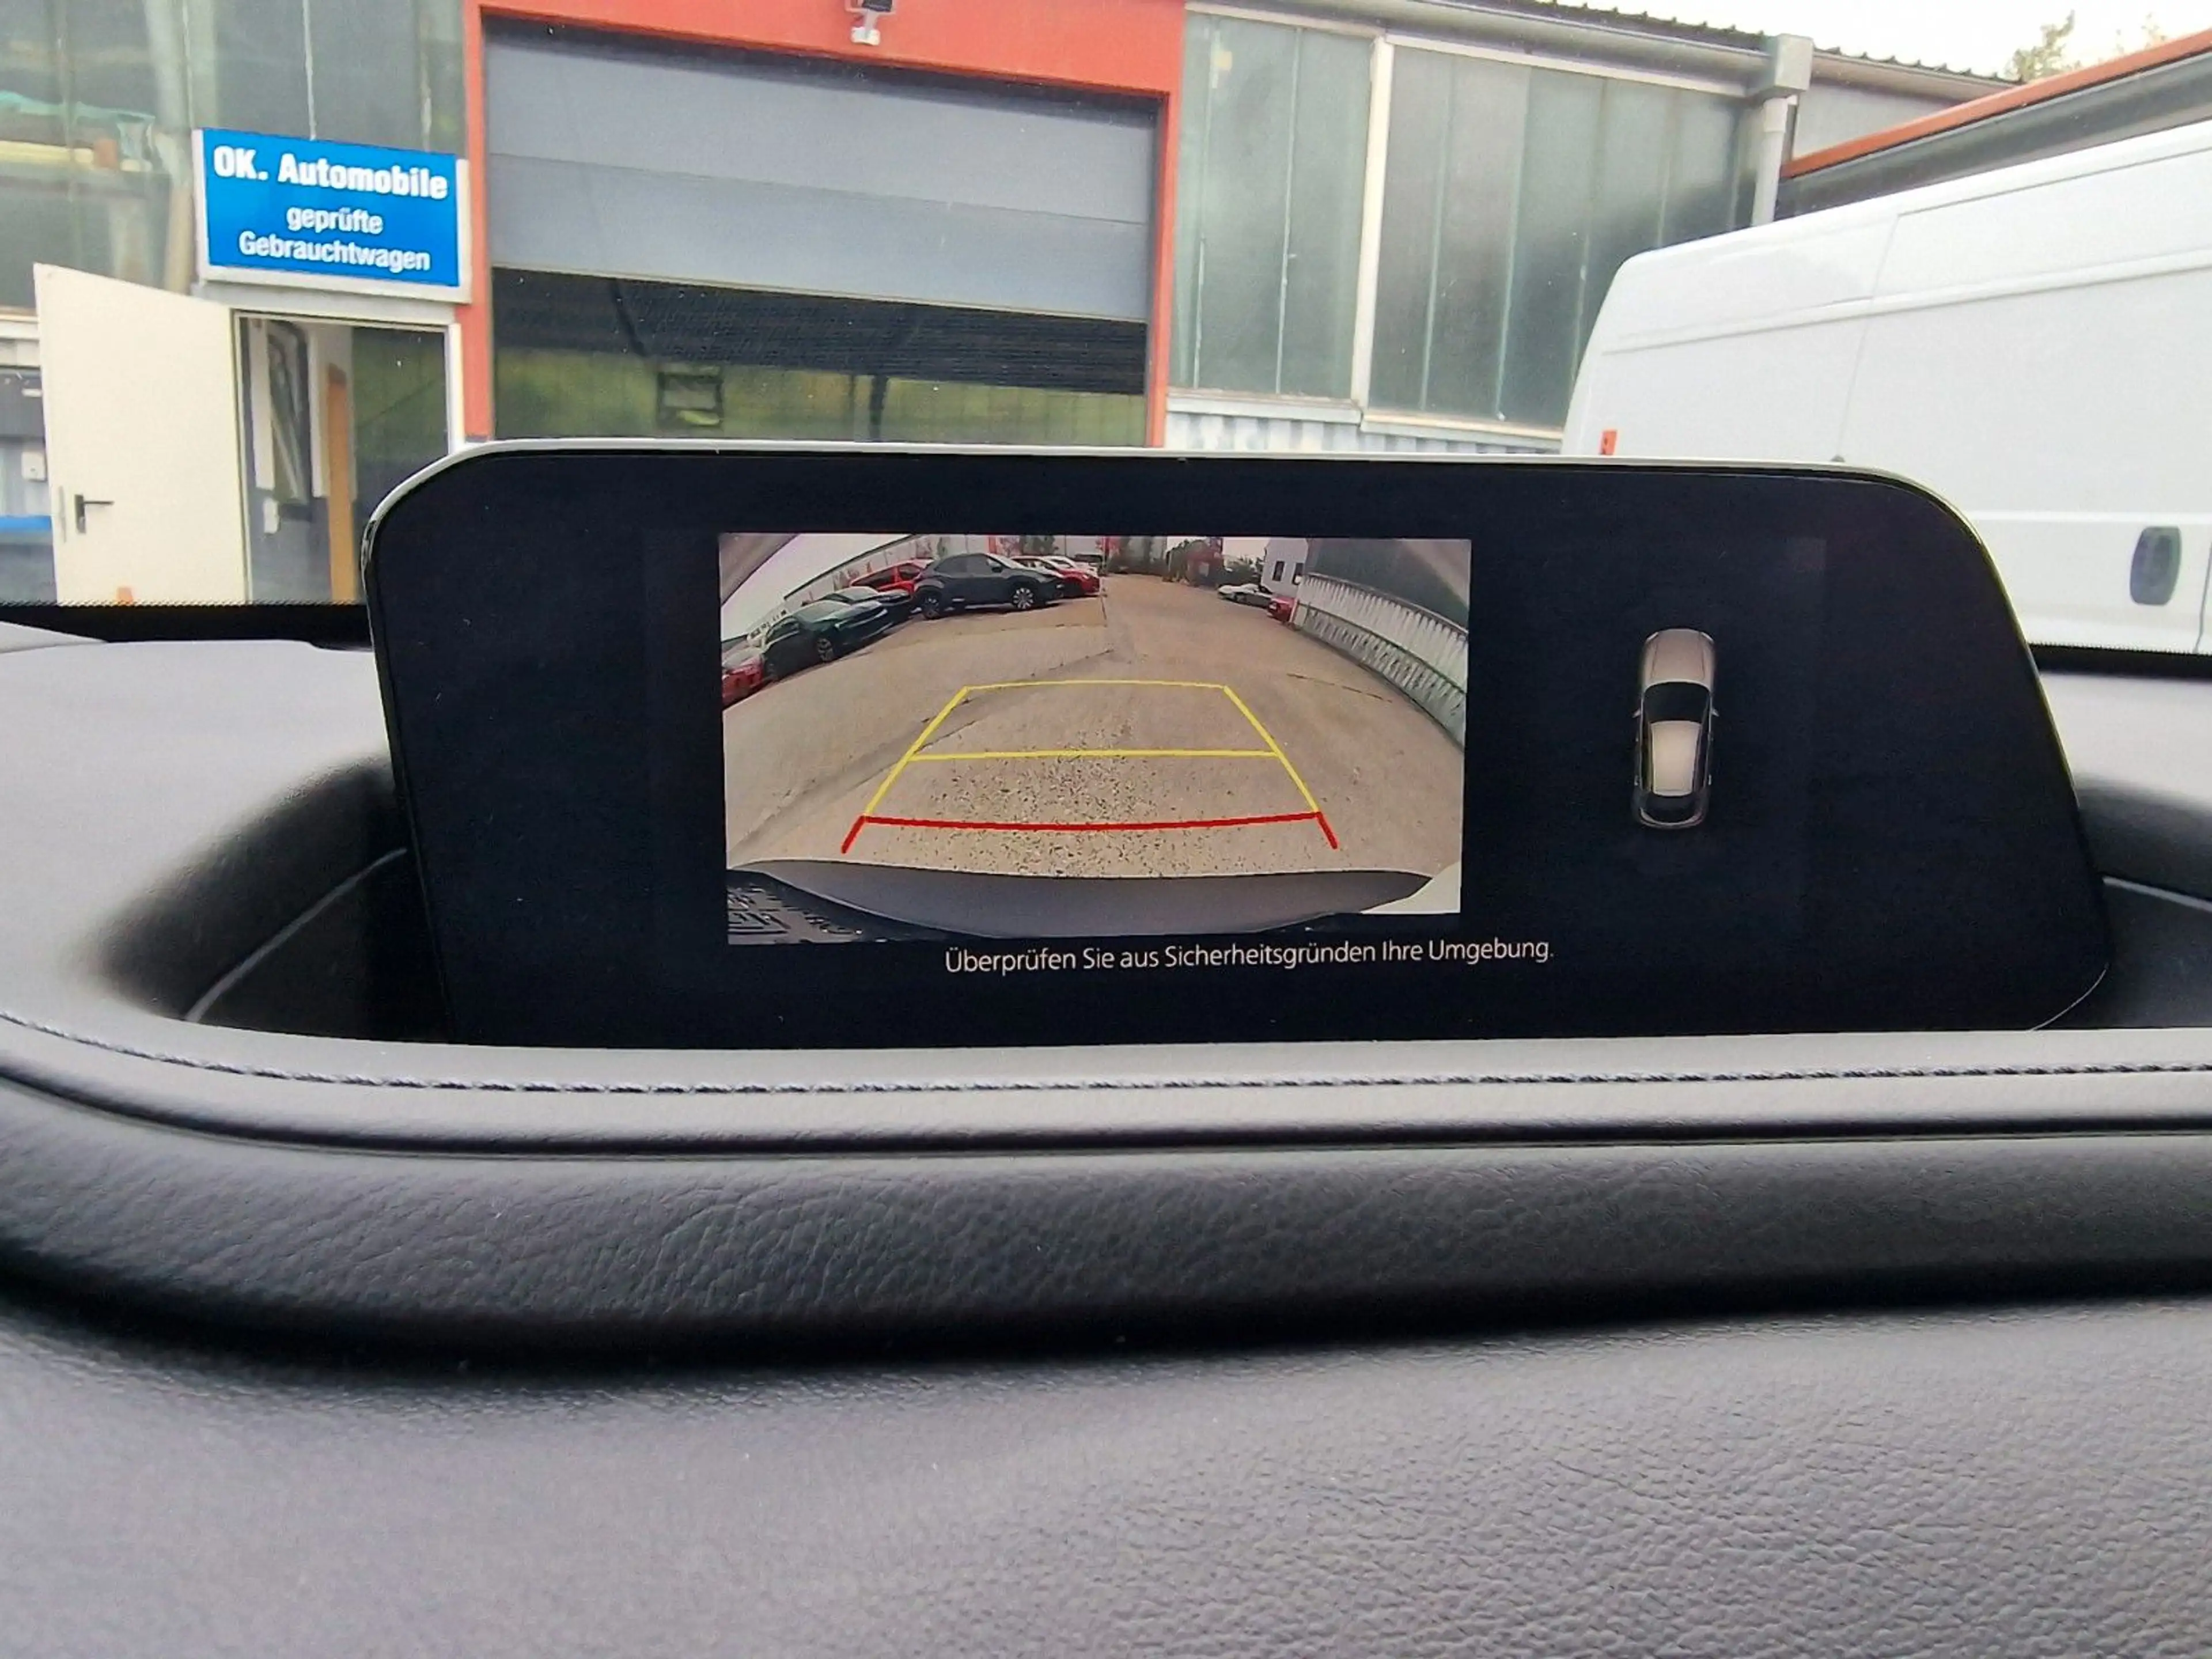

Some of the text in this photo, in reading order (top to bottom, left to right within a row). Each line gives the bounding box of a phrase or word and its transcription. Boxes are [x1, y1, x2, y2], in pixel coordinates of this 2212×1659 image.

[214, 146, 448, 199] OK. Automobile
[287, 207, 383, 234] geprüfte
[238, 231, 430, 272] Gebrauchtwagen
[945, 937, 1554, 975] Überprüfen Sie aus Sicherheitsgründen Ihre Umgebung.
